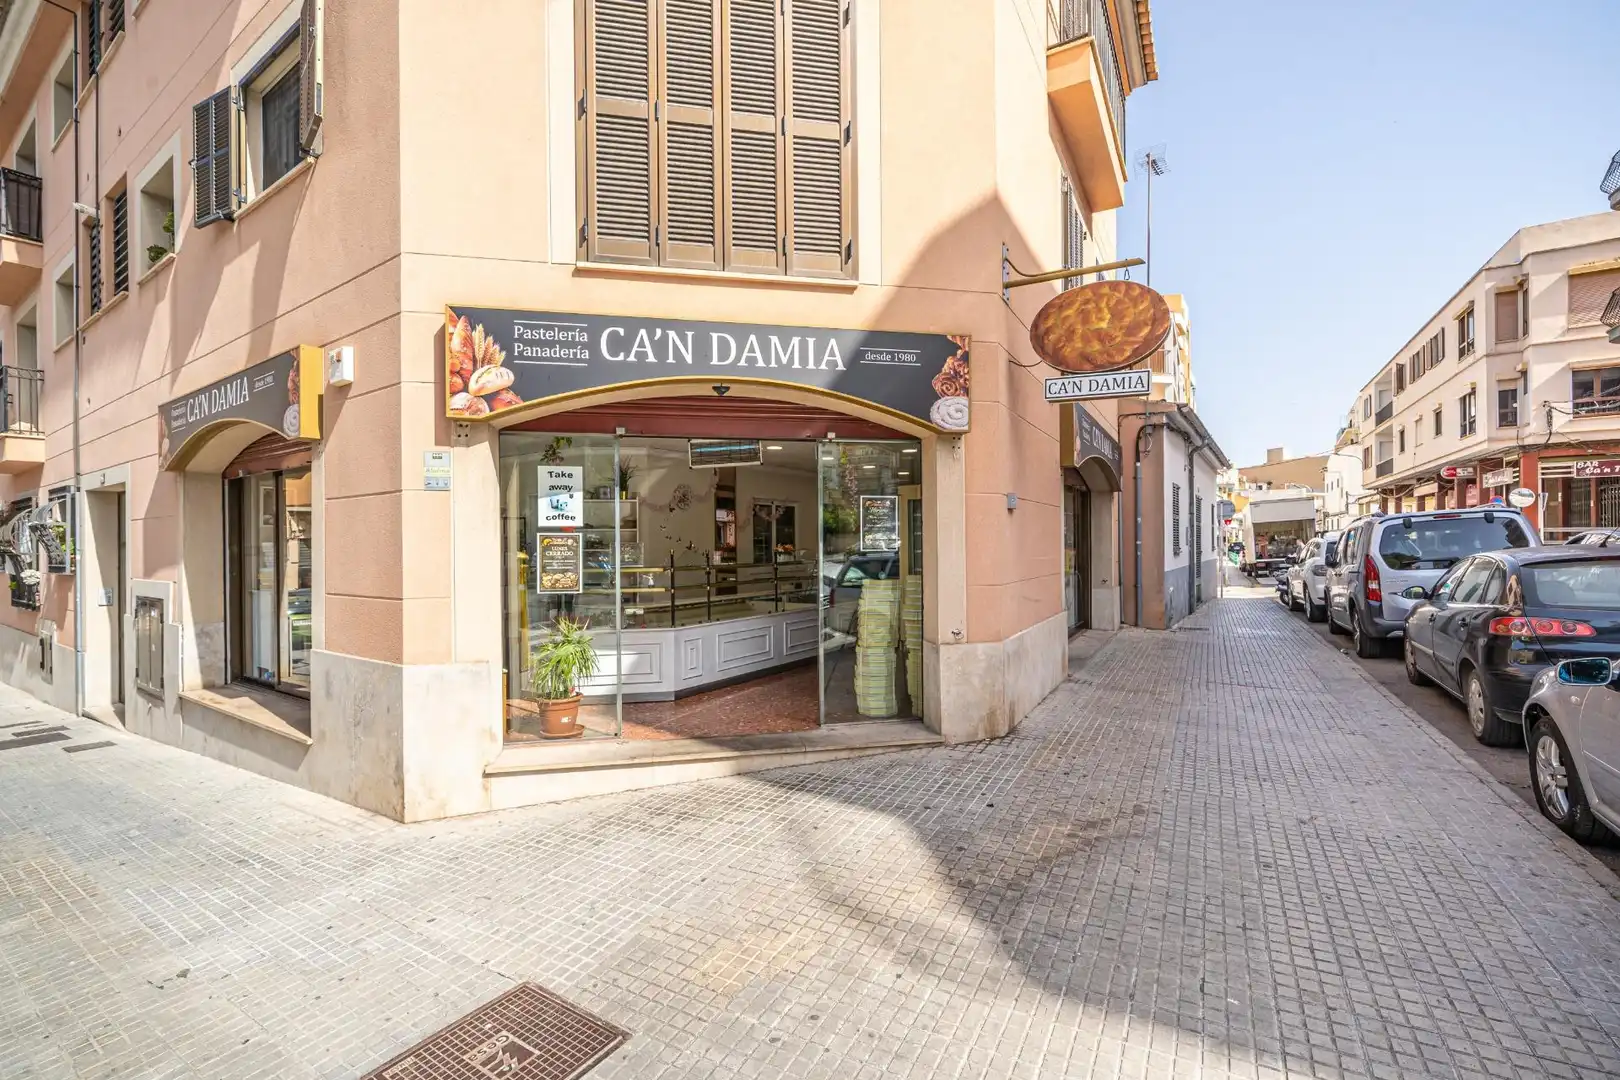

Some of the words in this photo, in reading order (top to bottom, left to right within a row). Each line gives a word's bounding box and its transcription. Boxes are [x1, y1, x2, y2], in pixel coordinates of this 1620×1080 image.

[513, 325, 588, 342] Pastelería
[513, 342, 590, 359] Panadería
[709, 331, 847, 371] DAMIA
[865, 351, 892, 361] desde
[894, 352, 917, 362] 1980
[1088, 375, 1146, 392] DAMIA
[211, 376, 249, 414] DAMIA
[1577, 460, 1599, 469] BAR
[547, 470, 574, 479] Take
[548, 484, 574, 493] away
[545, 513, 576, 521] coffee
[467, 1035, 510, 1062] Gesa
